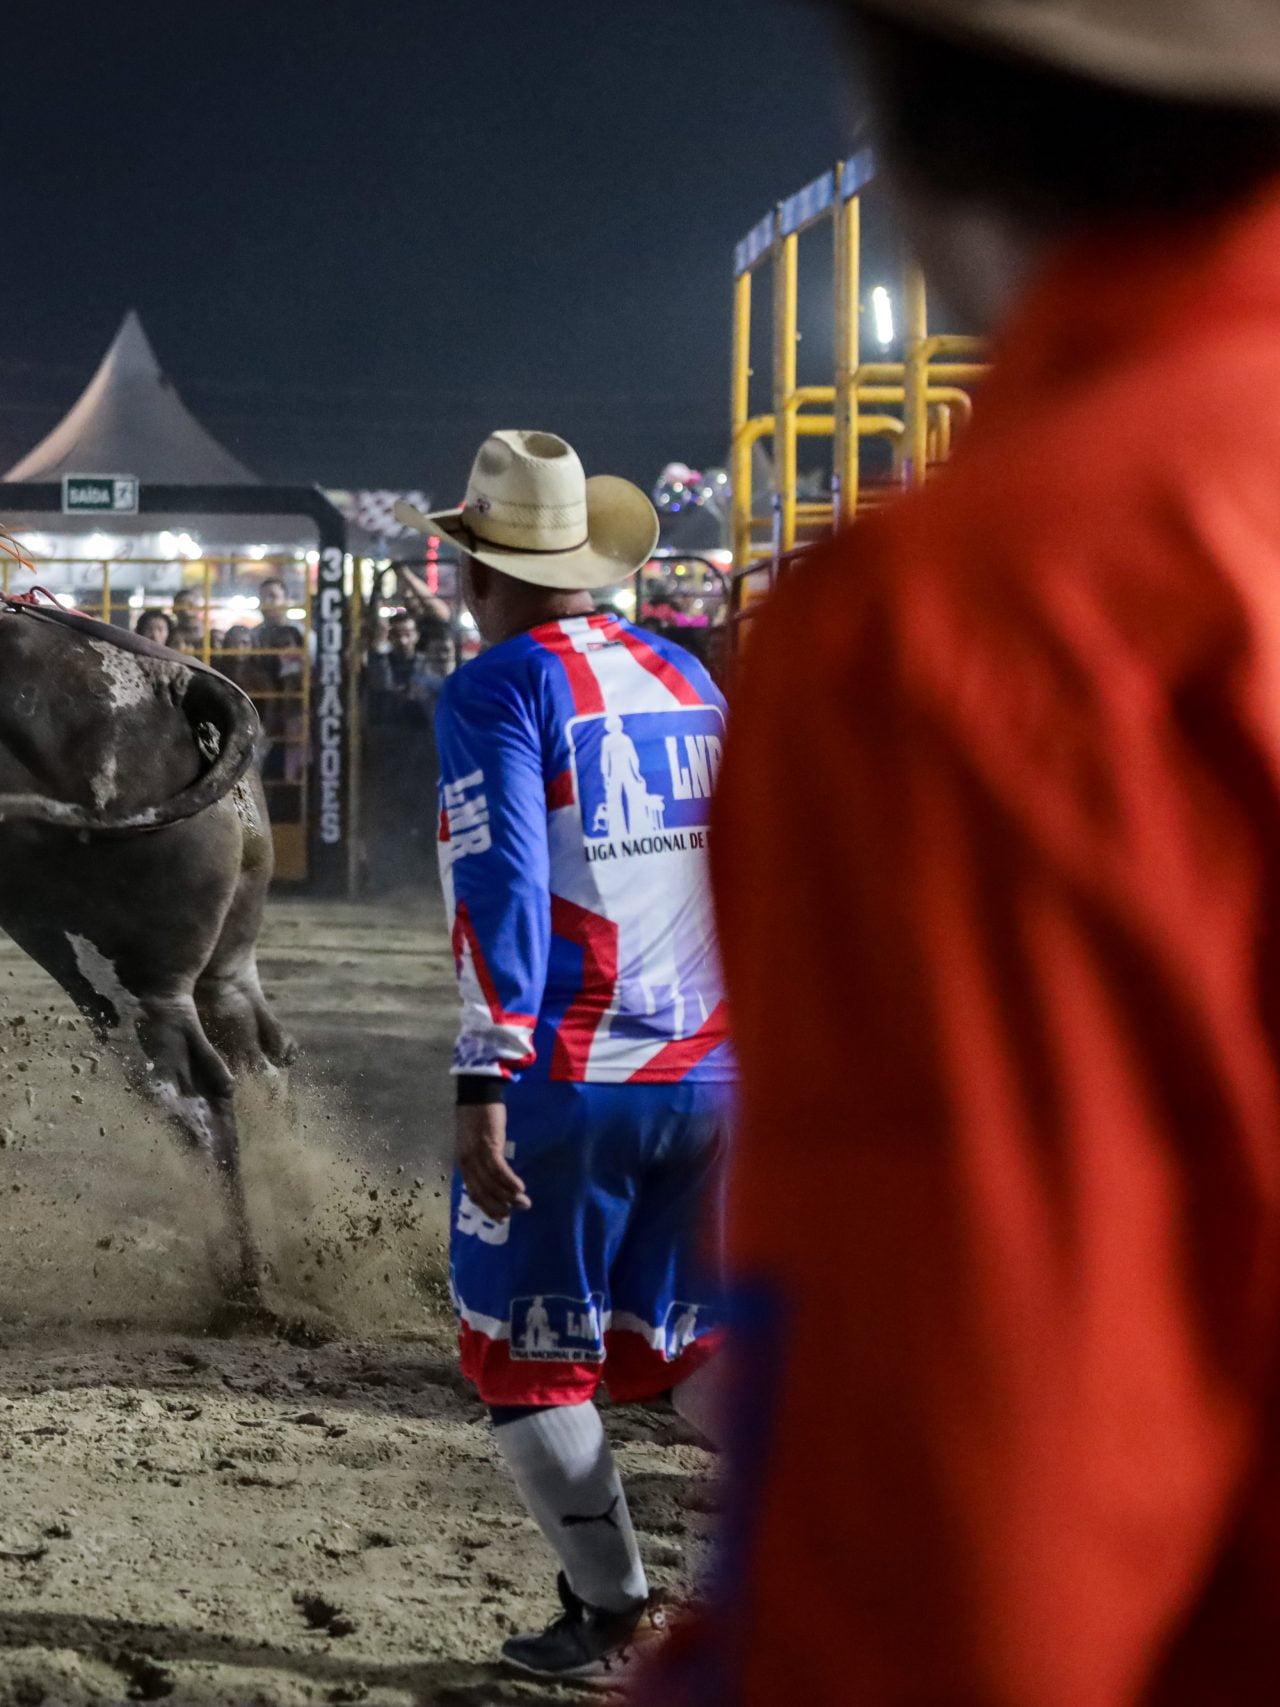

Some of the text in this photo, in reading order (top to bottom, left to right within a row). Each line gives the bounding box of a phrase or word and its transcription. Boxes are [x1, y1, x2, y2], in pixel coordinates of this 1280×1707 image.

[321, 547, 342, 582] 3
[584, 843, 617, 862] LIGA
[621, 834, 687, 857] NACIONAL
[690, 832, 704, 849] DE
